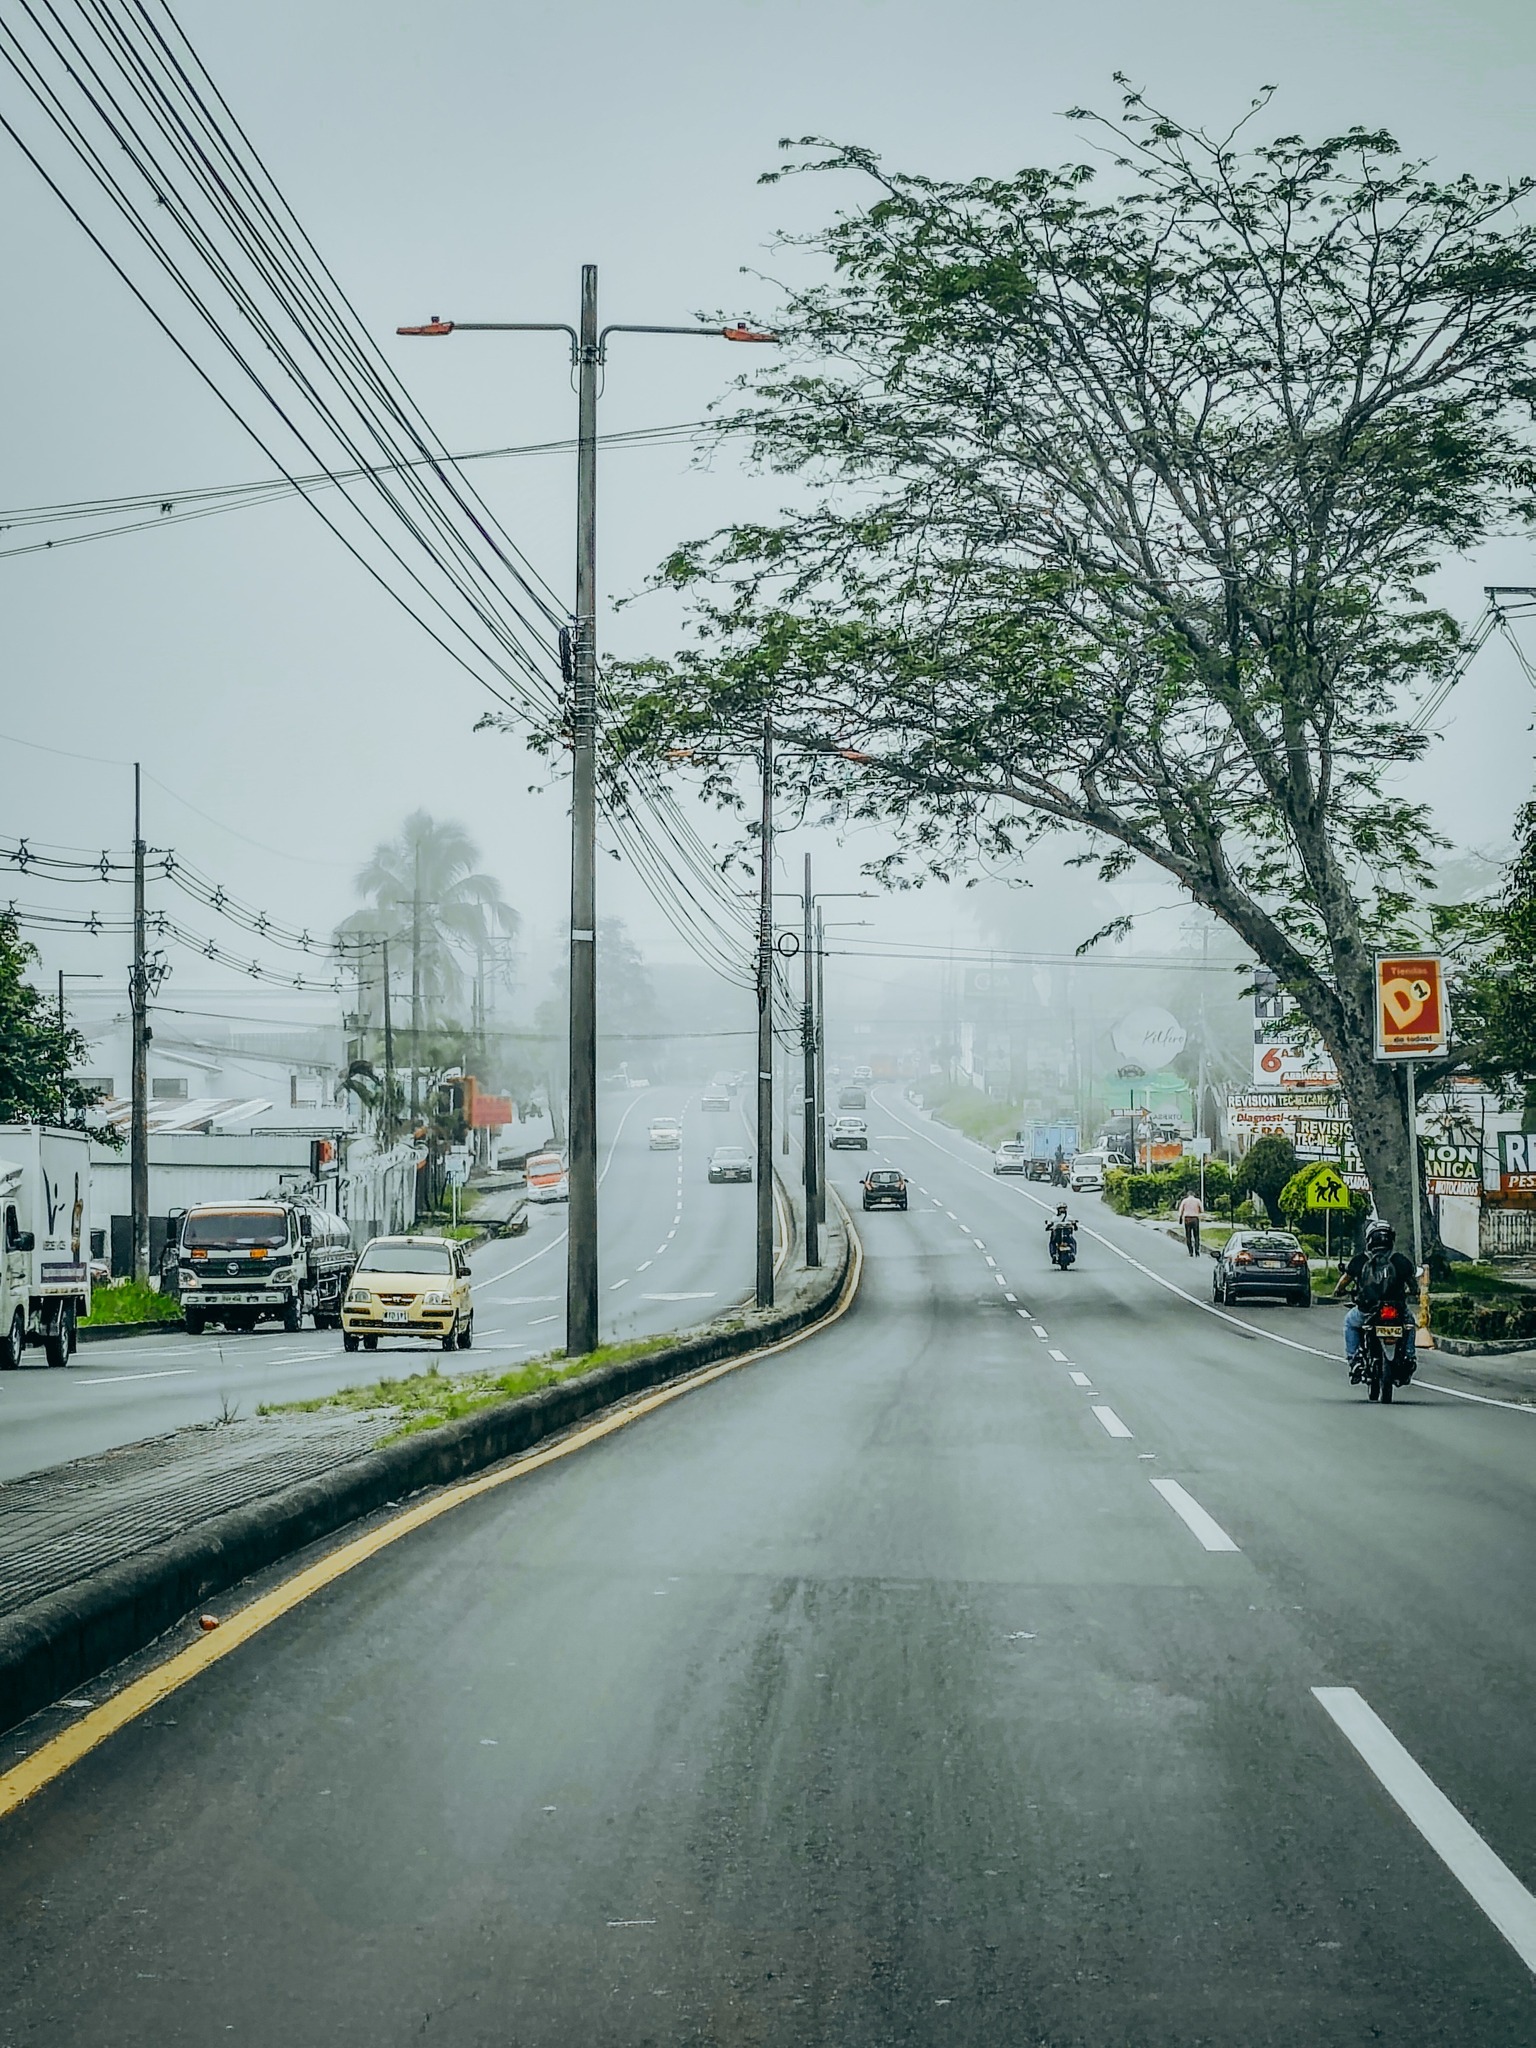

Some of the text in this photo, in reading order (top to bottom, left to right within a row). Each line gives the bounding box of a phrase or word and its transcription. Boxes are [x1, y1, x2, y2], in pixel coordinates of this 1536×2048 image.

[1261, 1047, 1282, 1072] 6
[1227, 1095, 1277, 1107] REVISION
[1508, 1175, 1536, 1188] PES
